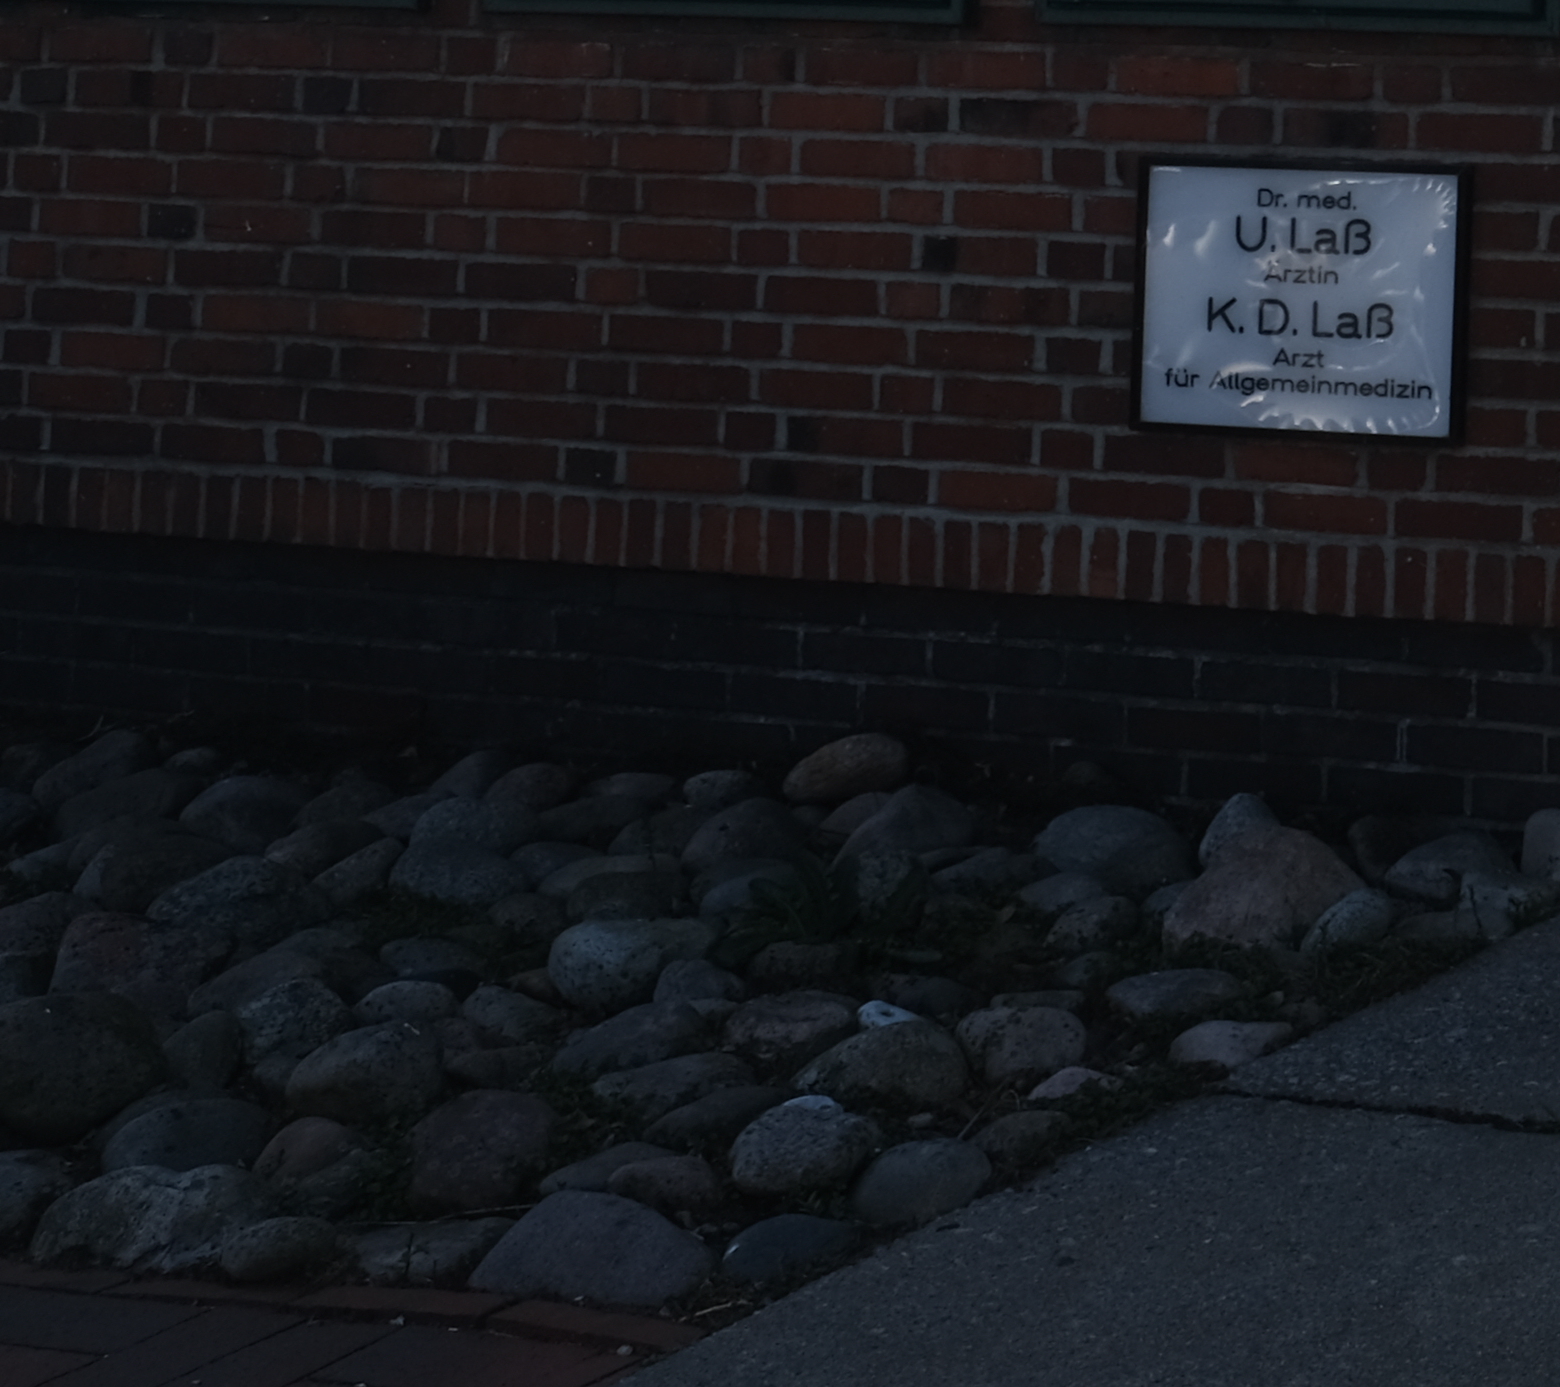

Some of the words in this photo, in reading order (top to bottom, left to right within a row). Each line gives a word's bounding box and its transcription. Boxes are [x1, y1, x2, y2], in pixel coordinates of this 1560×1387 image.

[1256, 188, 1287, 208] Dr.
[1297, 190, 1357, 211] med.
[1235, 215, 1276, 253] U.
[1290, 216, 1372, 255] Laß
[1264, 258, 1339, 284] Ärztin
[1207, 296, 1245, 334] K.
[1257, 298, 1298, 336] D.
[1311, 301, 1394, 339] Laß
[1272, 348, 1325, 369] Arzt
[1164, 367, 1199, 388] für
[1208, 371, 1433, 400] Allgemeinmedizin
